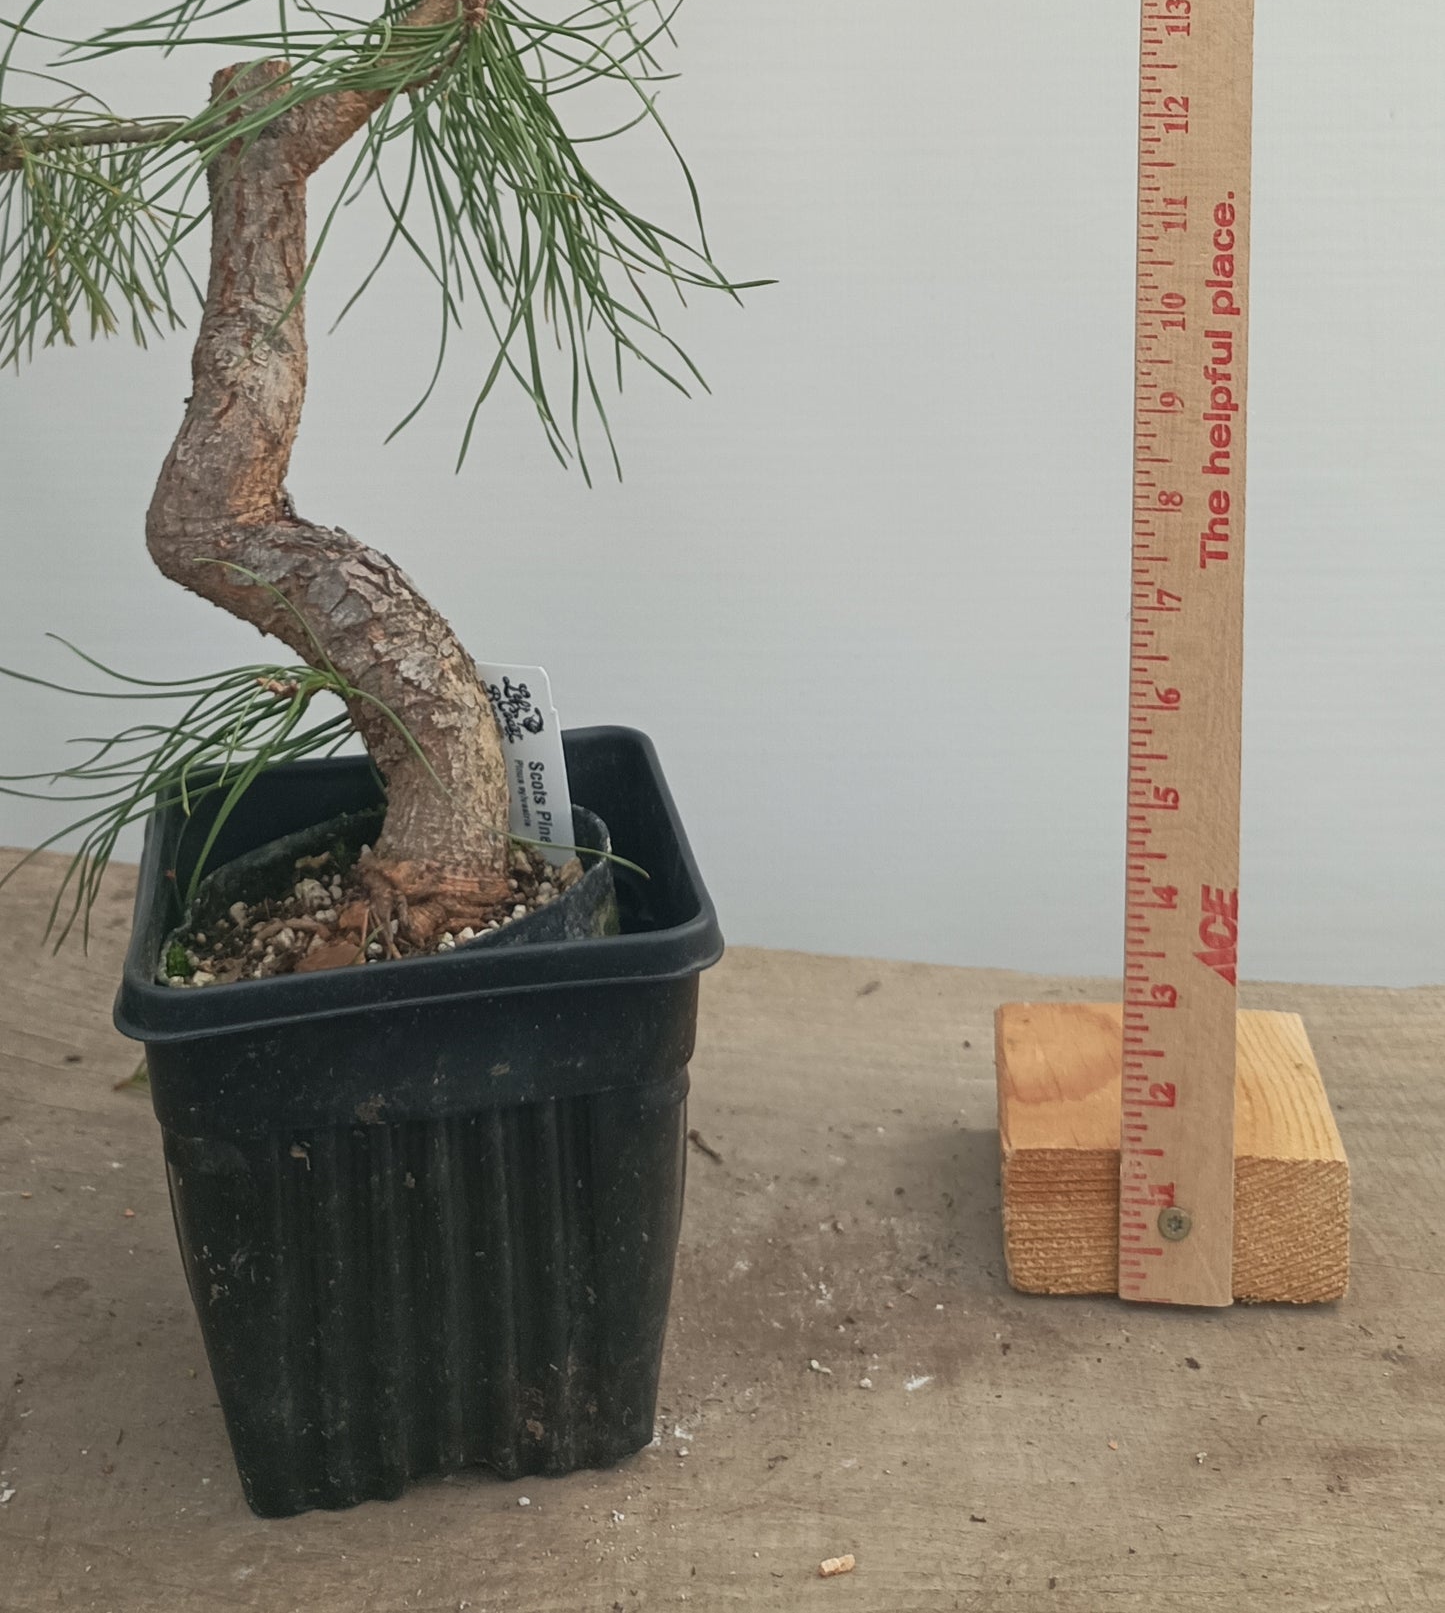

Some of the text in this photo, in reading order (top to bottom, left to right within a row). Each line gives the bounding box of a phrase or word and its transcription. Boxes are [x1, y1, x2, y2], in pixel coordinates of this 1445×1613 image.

[1164, 95, 1189, 135] 12
[1162, 195, 1187, 232] 11
[1160, 292, 1186, 332] 10
[1200, 191, 1241, 569] The helpful place.
[1159, 391, 1185, 409] 9
[1158, 490, 1184, 507] 8
[1156, 588, 1182, 606] 7
[1155, 687, 1181, 705] 6
[515, 759, 526, 784] Pinus
[529, 760, 553, 843] Scots Pine
[1153, 786, 1180, 804] 5
[1152, 885, 1178, 903] 4
[1192, 884, 1239, 987] ACE
[1150, 983, 1177, 1002] 3
[1150, 1082, 1176, 1102] 2
[1148, 1182, 1175, 1200] 1
